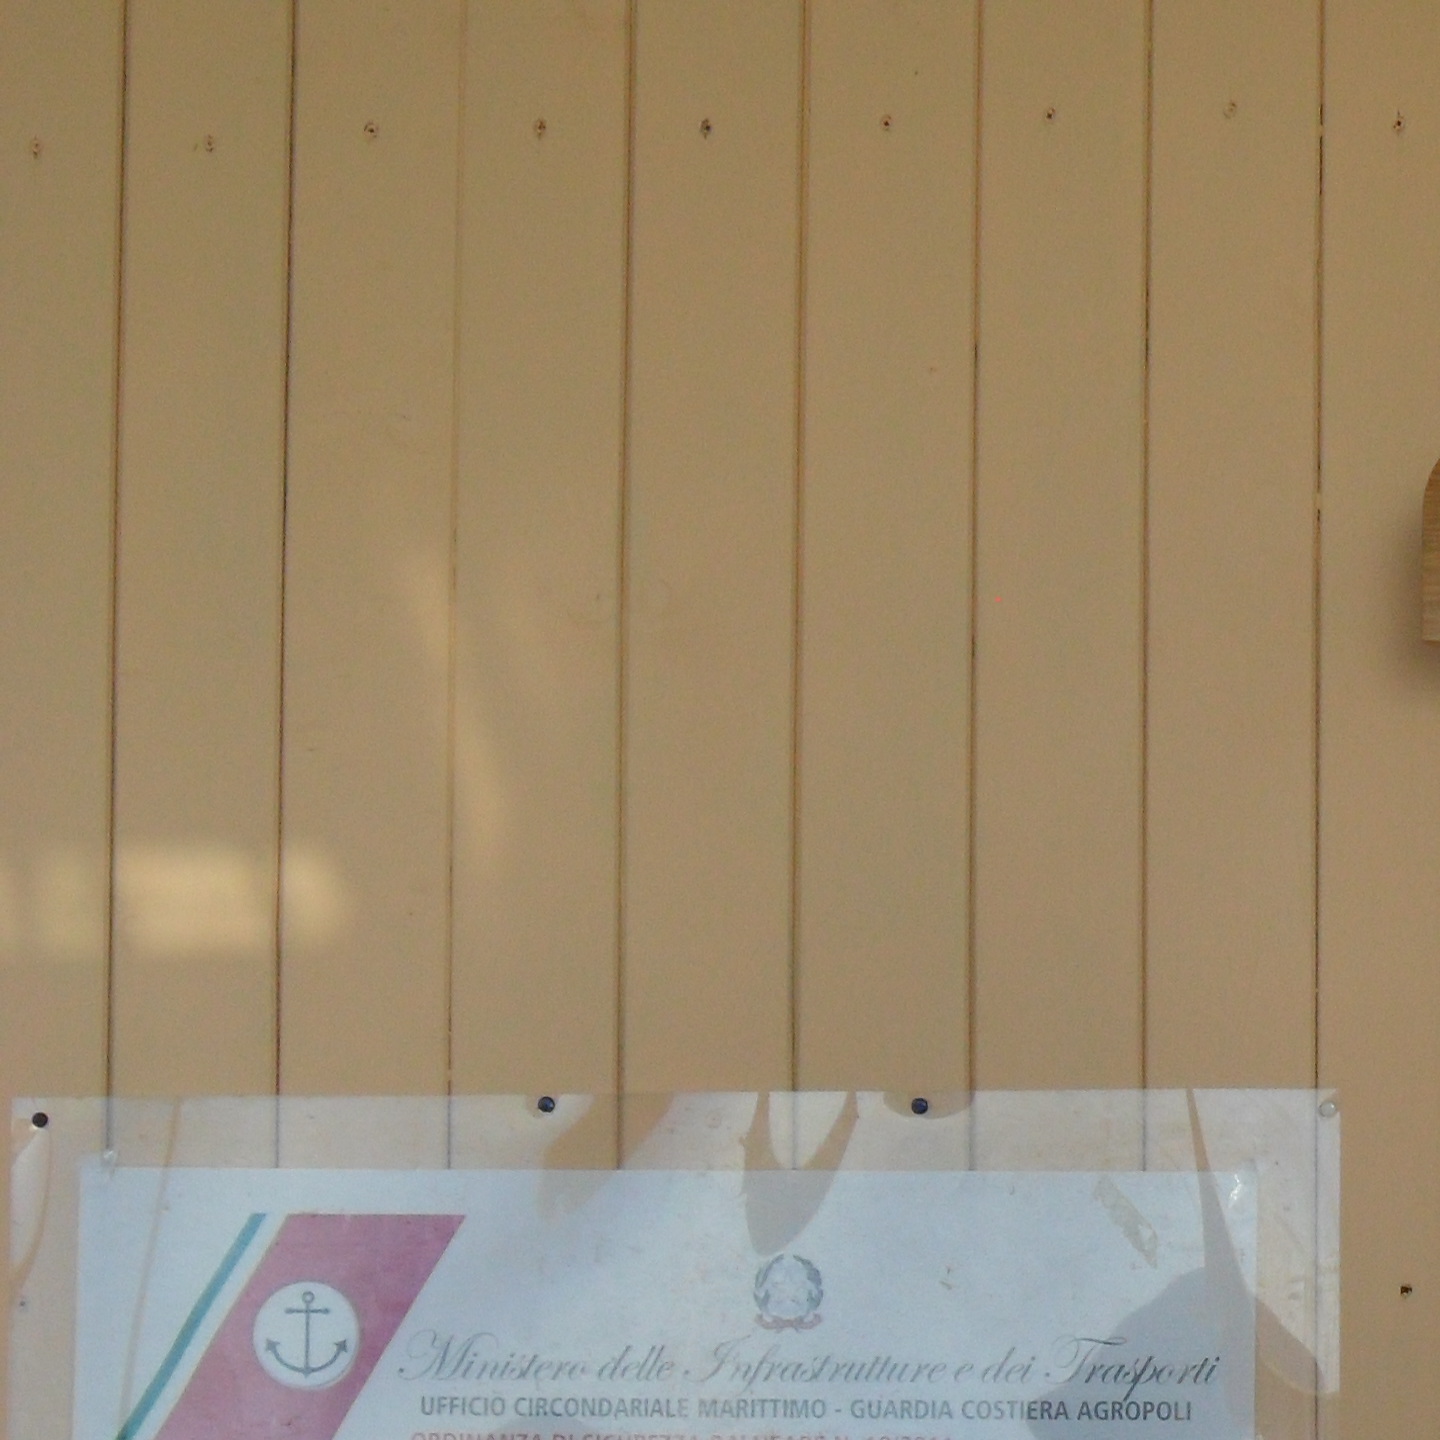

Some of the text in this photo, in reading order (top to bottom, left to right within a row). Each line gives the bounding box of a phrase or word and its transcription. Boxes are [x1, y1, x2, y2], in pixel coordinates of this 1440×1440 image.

[398, 1330, 590, 1383] Ministero
[599, 1345, 676, 1383] delle
[683, 1334, 945, 1389] Infrastrutture
[982, 1347, 1035, 1385] dei
[1043, 1334, 1220, 1400] Trasporti
[421, 1397, 1192, 1421] UFFICIO CIRCONDARIALE MARITTIMO GUARDIA COSTIERA AGROPOLI
